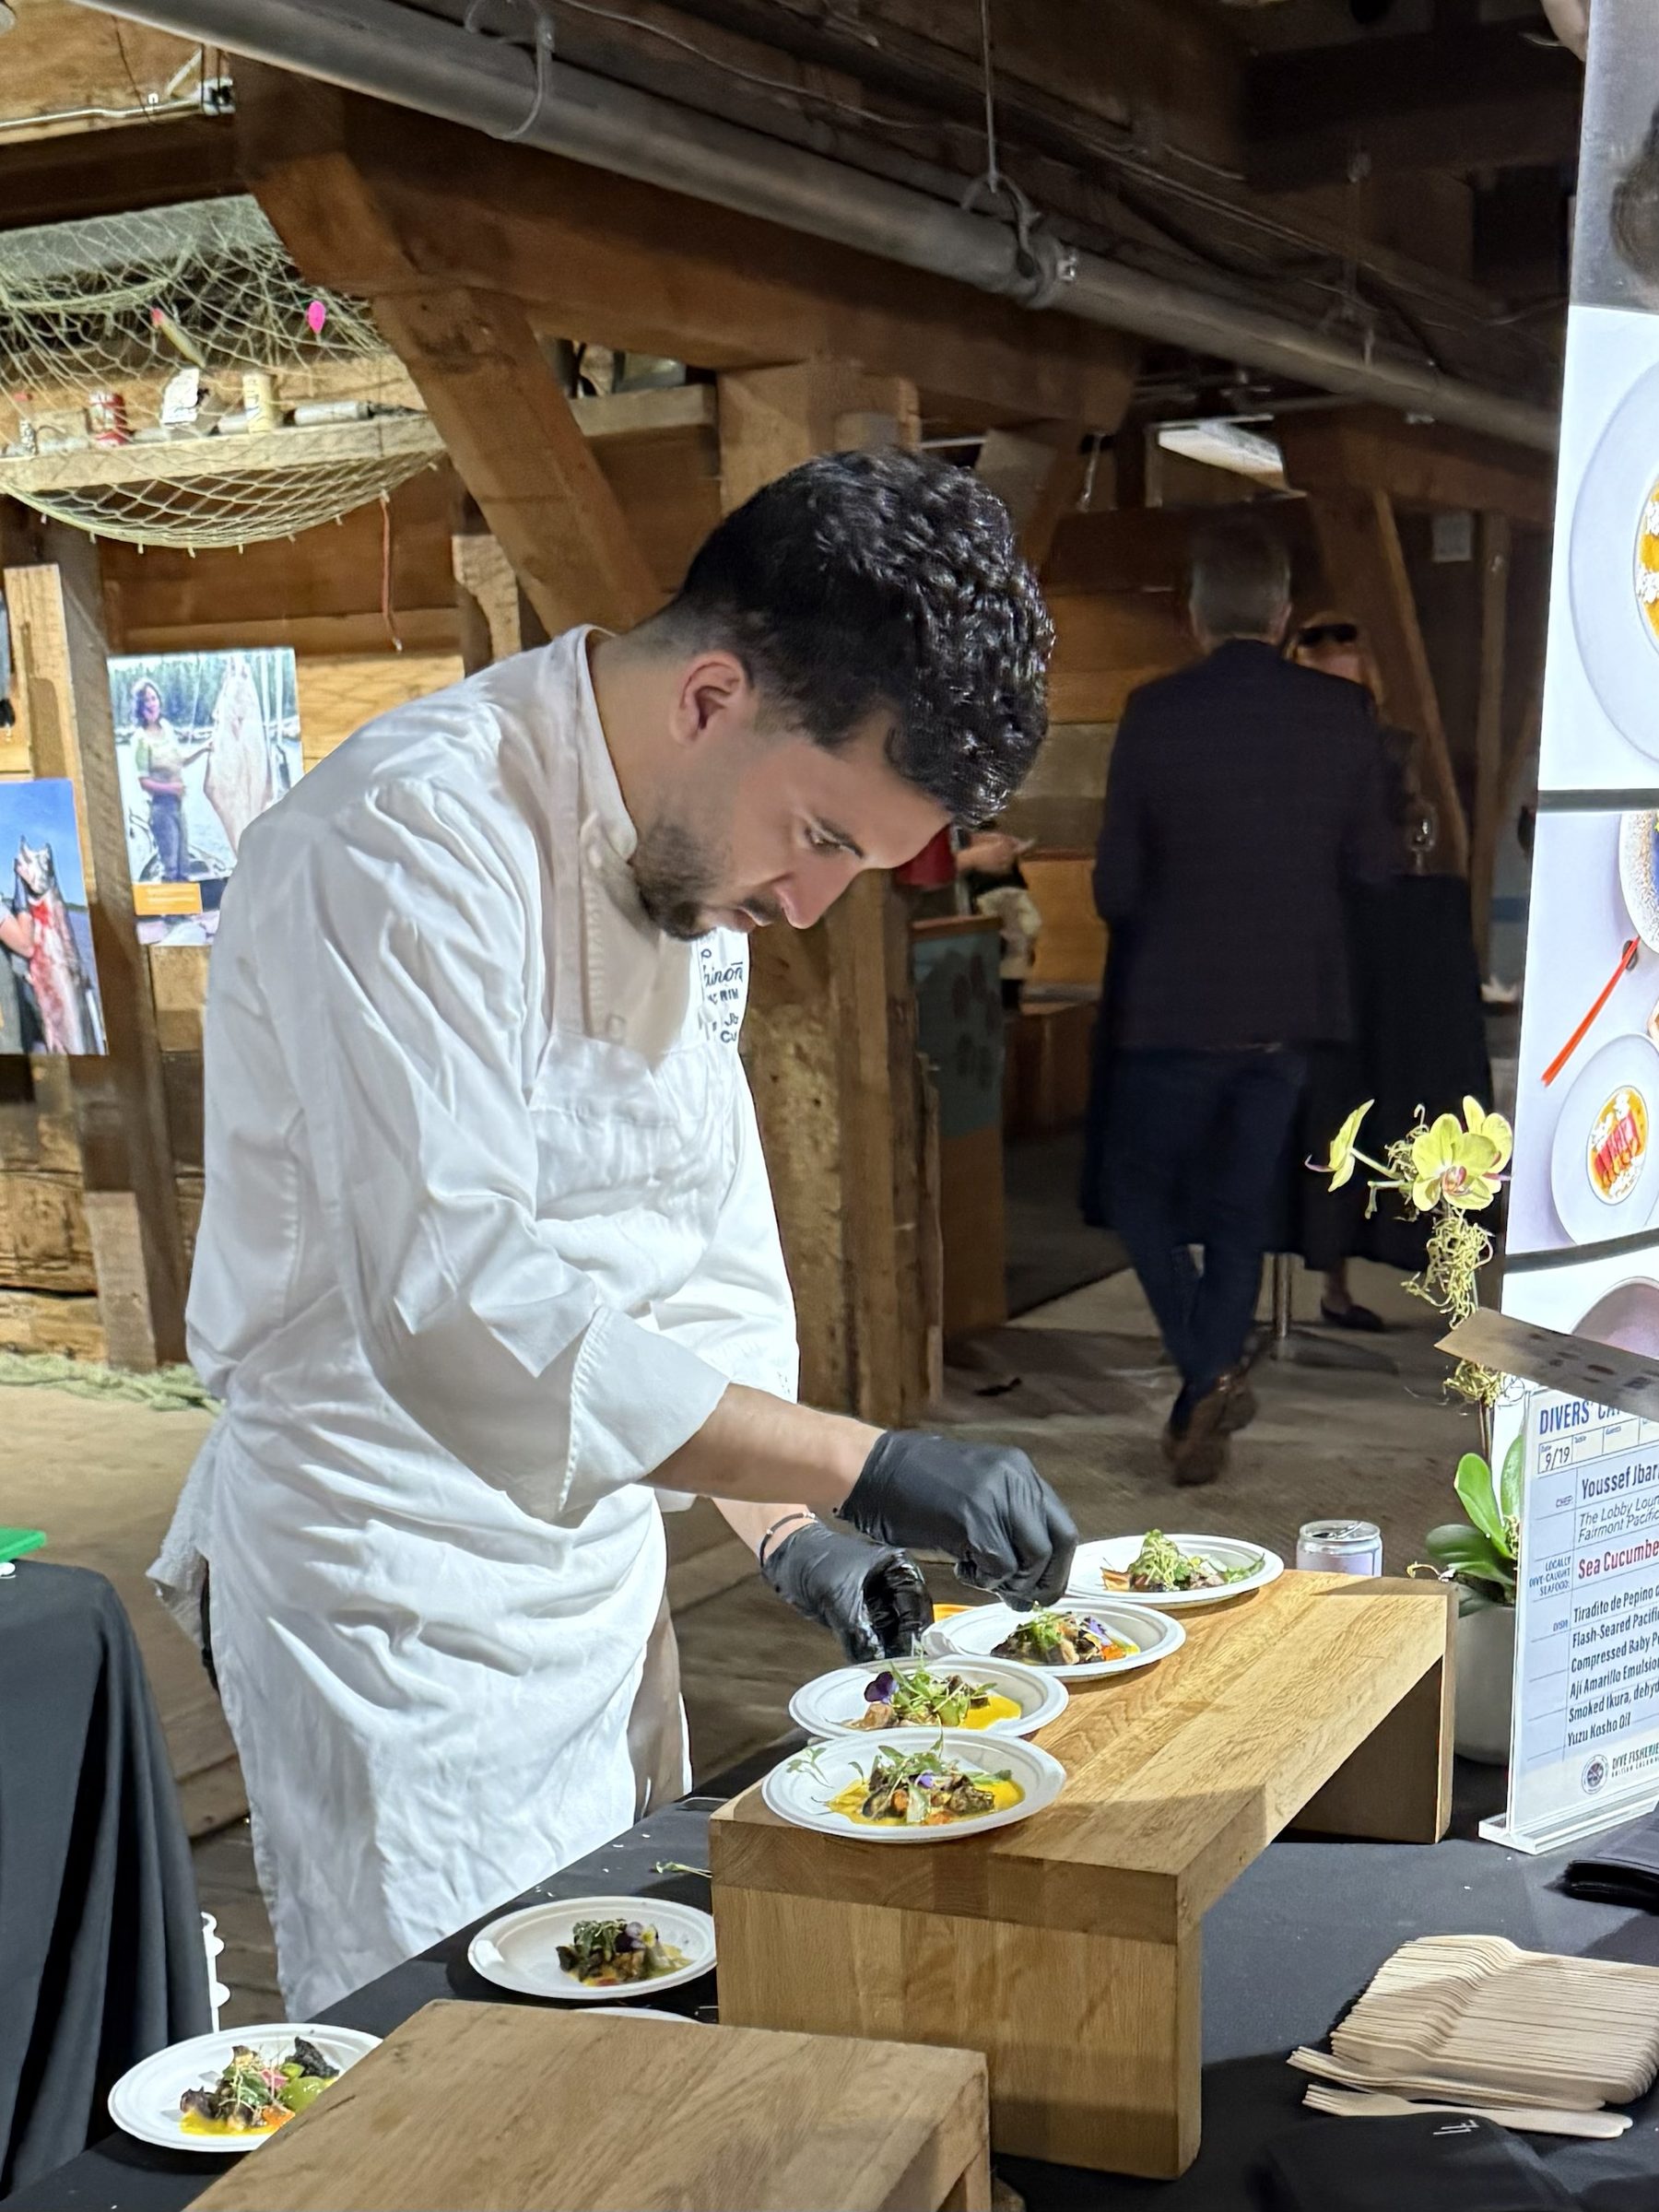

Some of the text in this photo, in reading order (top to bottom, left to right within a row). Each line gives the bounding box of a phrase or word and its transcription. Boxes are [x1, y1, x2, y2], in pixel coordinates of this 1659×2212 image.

[1545, 1446, 1571, 1471] 9/19
[1582, 1463, 1659, 1500] Youssef Jbar
[1578, 1518, 1624, 1543] Fairmont
[1580, 1512, 1598, 1527] The
[1601, 1501, 1633, 1522] Lobby
[1578, 1558, 1601, 1580] Sea
[1574, 1600, 1609, 1623] Tiradito
[1610, 1594, 1622, 1611] de
[1623, 1586, 1653, 1607] Pepino
[1572, 1615, 1631, 1649] Flash-Seared
[1571, 1641, 1627, 1673] Compressed
[1629, 1635, 1651, 1654] Baby
[1583, 1669, 1621, 1694] Amarillo
[1569, 1695, 1605, 1724] Smoked
[1606, 1691, 1631, 1710] Ikura,
[1568, 1711, 1631, 1747] Yuzu Kosho Oil
